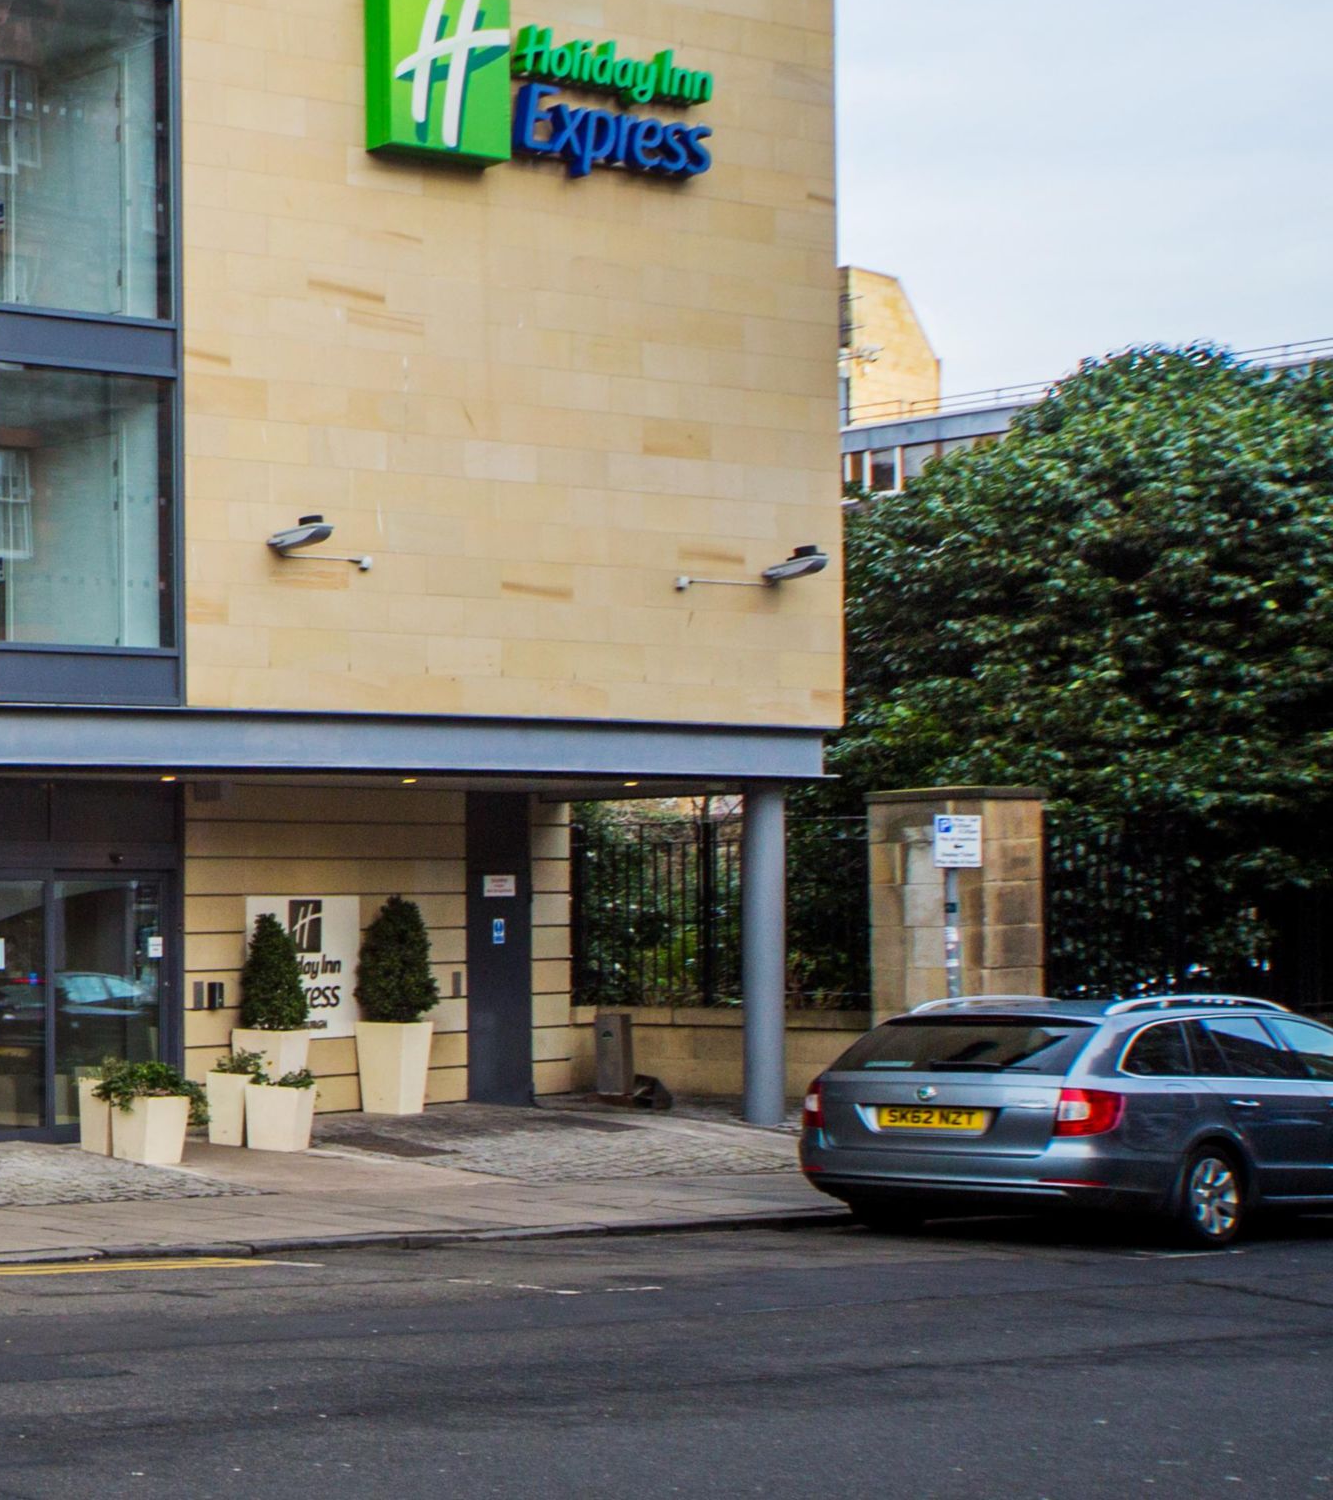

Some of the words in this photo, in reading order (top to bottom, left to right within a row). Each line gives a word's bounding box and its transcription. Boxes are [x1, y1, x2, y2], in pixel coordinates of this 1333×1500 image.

[515, 24, 659, 104] Holiday
[656, 49, 714, 103] Inn
[515, 83, 713, 178] Express
[321, 954, 342, 974] Inn
[304, 985, 341, 1008] ress
[887, 1108, 933, 1125] SK62
[938, 1110, 975, 1126] NZT
